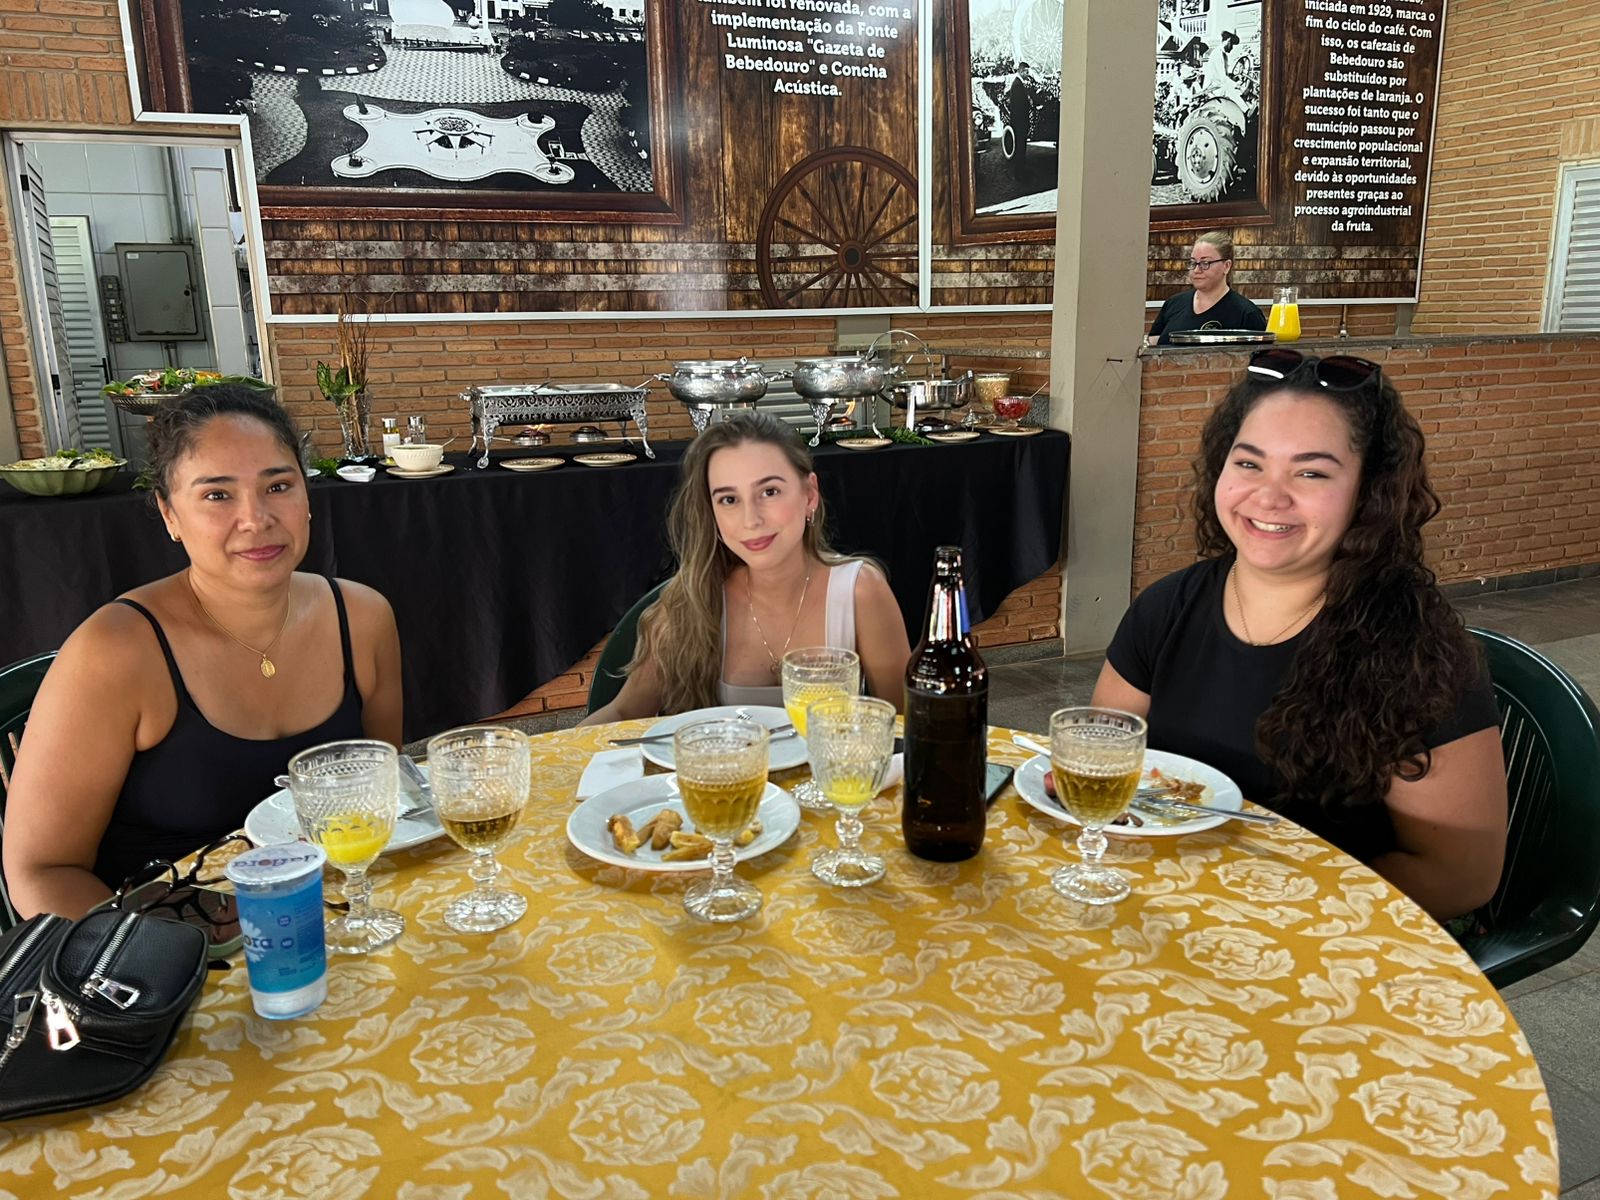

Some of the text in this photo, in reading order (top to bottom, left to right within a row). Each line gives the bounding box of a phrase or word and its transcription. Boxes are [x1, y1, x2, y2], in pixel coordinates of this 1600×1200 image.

[789, 0, 864, 17] renovada,
[868, 6, 898, 18] com
[902, 9, 911, 19] a
[1305, 0, 1347, 13] iniciada
[1369, 4, 1394, 19] 1929,
[1396, 11, 1426, 20] marca
[1429, 13, 1435, 22] o
[711, 10, 898, 38] implementação da Fonte
[1305, 16, 1432, 38] fim do ciclo do café. Com
[726, 33, 885, 58] Luminosa "Gazeta de
[1321, 34, 1415, 53] isso, os cafezais de
[725, 55, 887, 79] Bebedouro" e Concha
[1330, 53, 1404, 69] Bebedouro são
[774, 79, 842, 96] Acústica.
[1324, 71, 1407, 88] substituídos por
[1303, 86, 1423, 105] plantações de laranja. O
[1305, 105, 1419, 121] sucesso foi tanto que o
[1306, 122, 1415, 138] município passou por
[1294, 138, 1423, 154] crescimento populacional
[1303, 155, 1411, 169] e expansão territorial,
[1295, 170, 1417, 185] devido às oportunidades
[1306, 189, 1403, 202] presentes graças ao
[1295, 205, 1411, 218] processo agroindustrial
[1331, 220, 1373, 231] da fruta.
